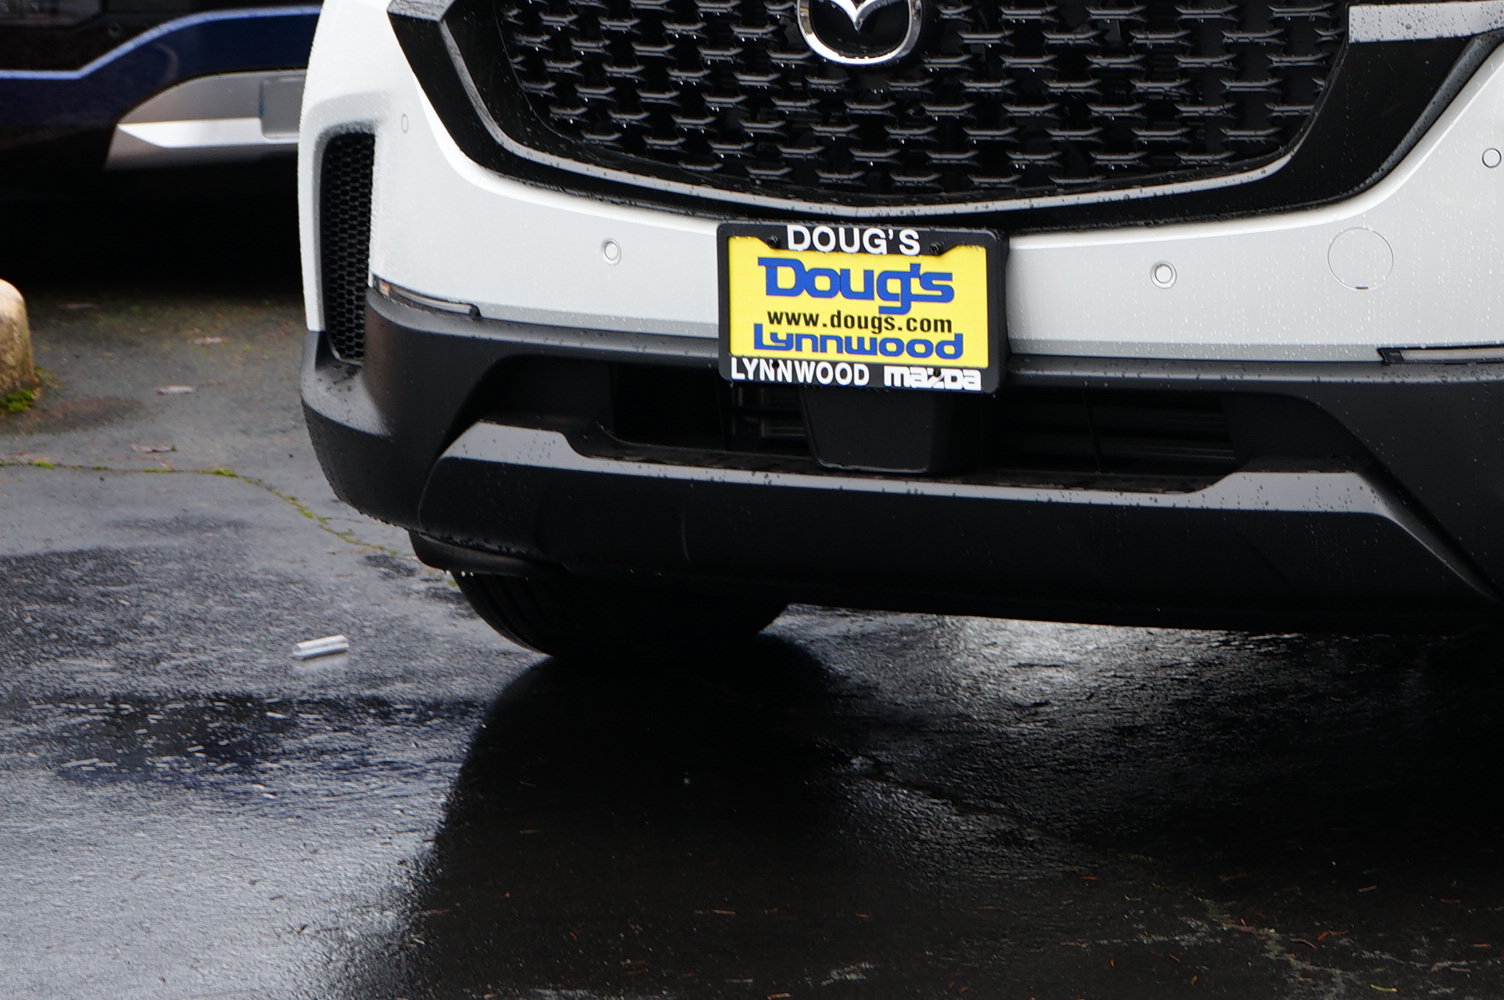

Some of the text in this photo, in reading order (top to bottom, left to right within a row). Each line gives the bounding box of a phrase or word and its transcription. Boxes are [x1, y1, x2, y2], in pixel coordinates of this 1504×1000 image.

[787, 224, 920, 255] DOUG'S
[757, 256, 956, 315] Doug's
[767, 310, 953, 334] www.dougs.com
[753, 323, 964, 360] Lynnwood
[730, 356, 870, 387] LYNNWOOD
